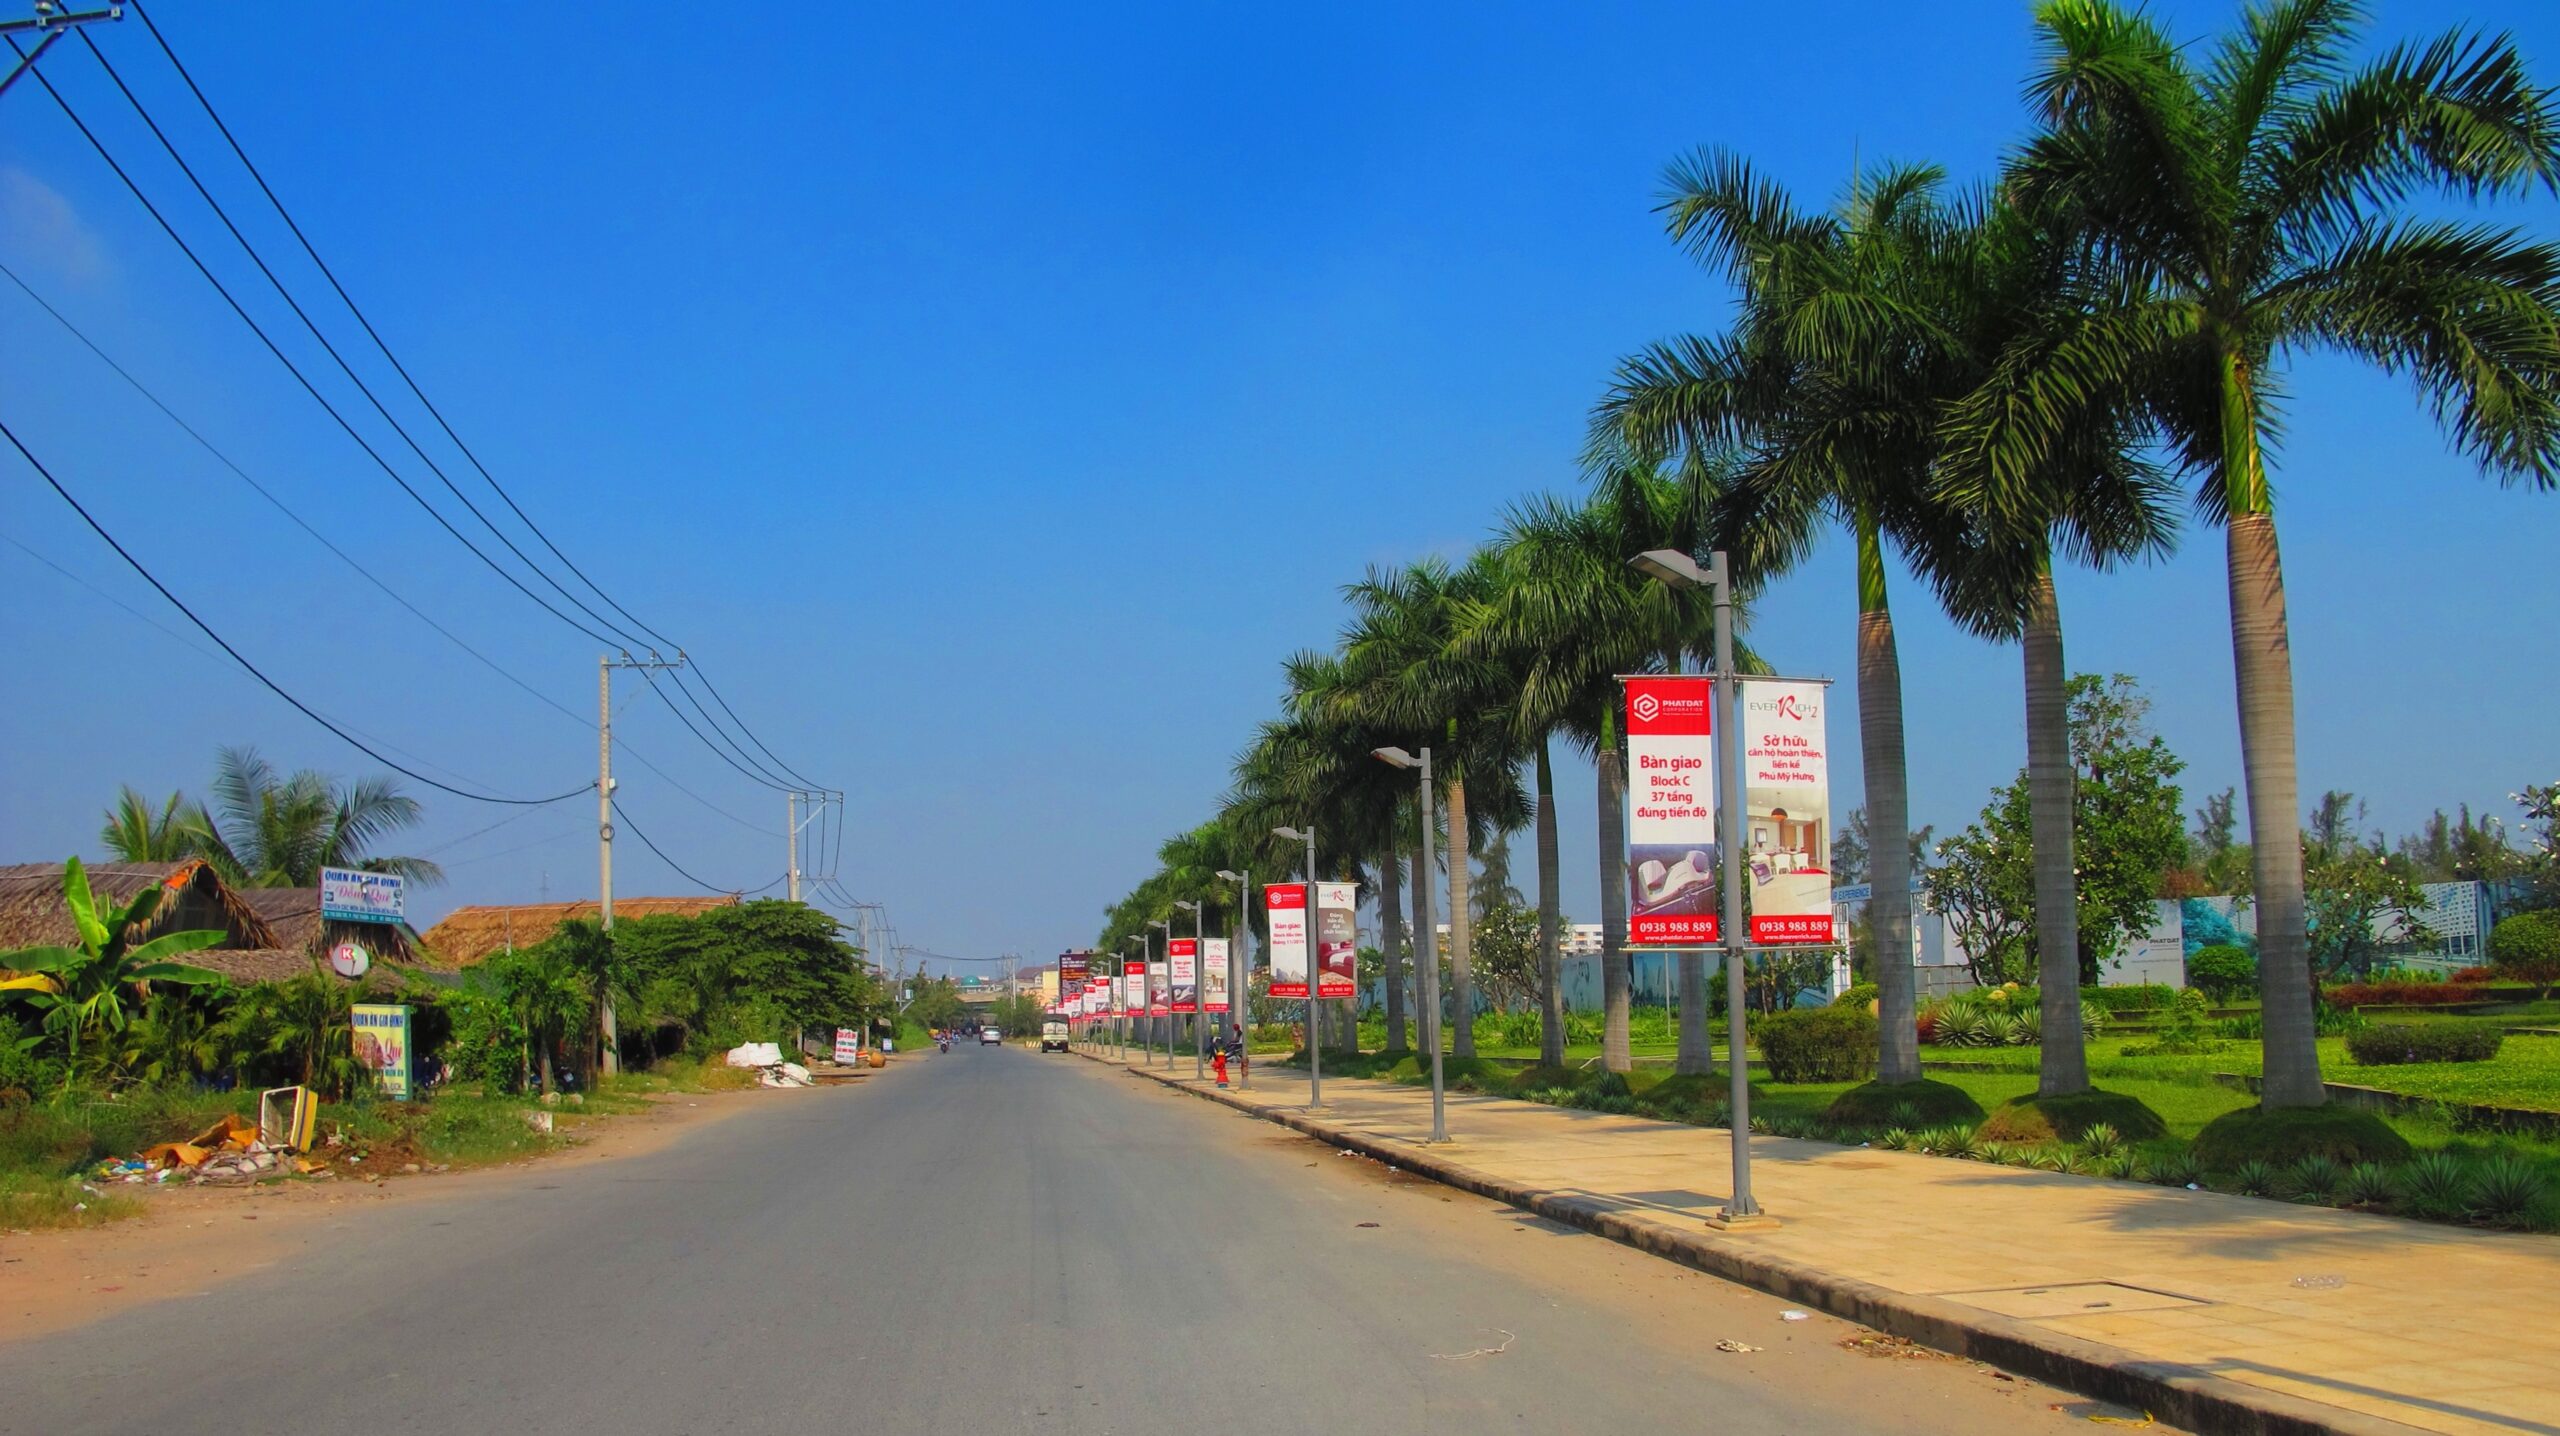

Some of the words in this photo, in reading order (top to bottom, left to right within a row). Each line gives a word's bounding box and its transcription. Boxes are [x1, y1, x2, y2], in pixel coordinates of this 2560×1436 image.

[1810, 706, 1818, 718] 2
[1763, 734, 1780, 747] Sở
[1782, 735, 1808, 747] hữu
[1764, 748, 1776, 759] hộ
[1776, 748, 1800, 757] hoàn
[1640, 754, 1668, 769] Bàn
[1670, 754, 1702, 773] giao
[1650, 775, 1681, 787] Block
[1682, 775, 1691, 787] C
[1758, 771, 1776, 781] Phú
[1777, 772, 1791, 783] Mỹ
[1792, 772, 1815, 783] Hưng
[1651, 791, 1665, 802] 37
[1637, 806, 1667, 820] đúng
[1668, 805, 1691, 818] tiến
[1692, 806, 1707, 821] độ
[1838, 887, 1870, 900] EXPERIENCE
[1639, 922, 1666, 933] 0938
[1669, 922, 1689, 932] 988
[1692, 921, 1712, 932] 889
[1759, 921, 1785, 932] 0938
[1788, 920, 1808, 932] 988
[1810, 920, 1829, 932] 889
[1644, 934, 1705, 942] www.phatdat.com.vn
